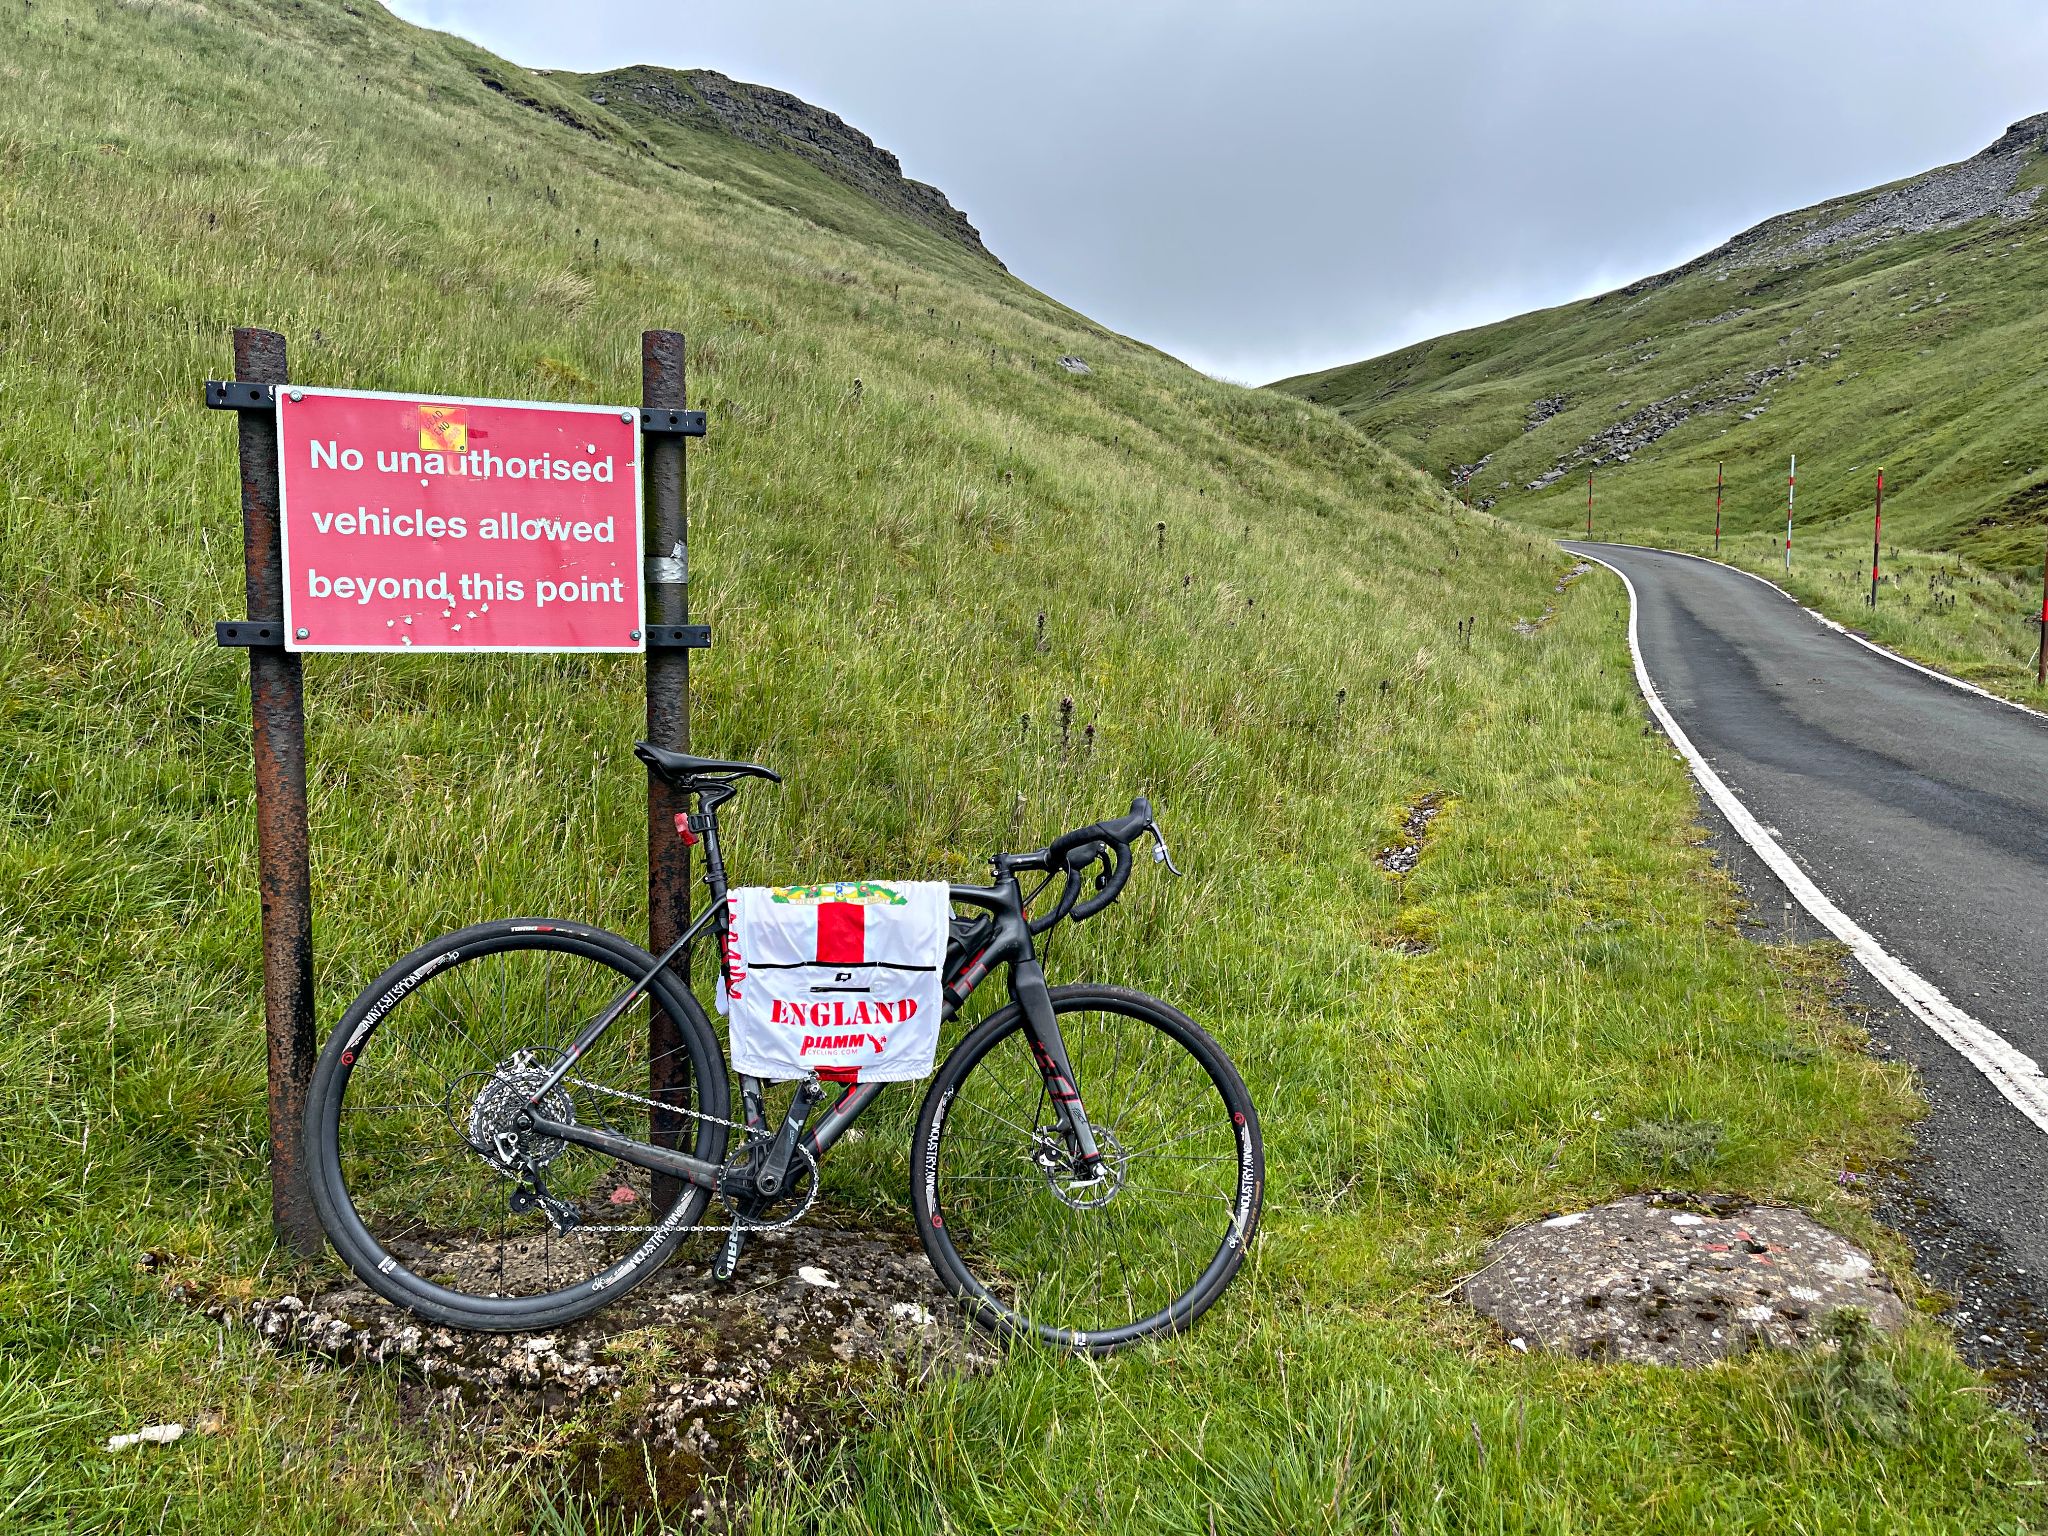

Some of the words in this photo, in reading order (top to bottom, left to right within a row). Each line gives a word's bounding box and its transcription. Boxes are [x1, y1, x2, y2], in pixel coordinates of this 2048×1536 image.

[310, 438, 364, 470] No
[377, 449, 614, 483] unauthorised
[312, 507, 468, 539] vehicles
[479, 511, 615, 543] allowed
[309, 568, 448, 606] beyond
[458, 571, 525, 602] this
[536, 574, 625, 608] point
[770, 998, 918, 1027] ENGLAND
[800, 1034, 865, 1056] PJAMM
[807, 1048, 858, 1056] CYCLING.COM
